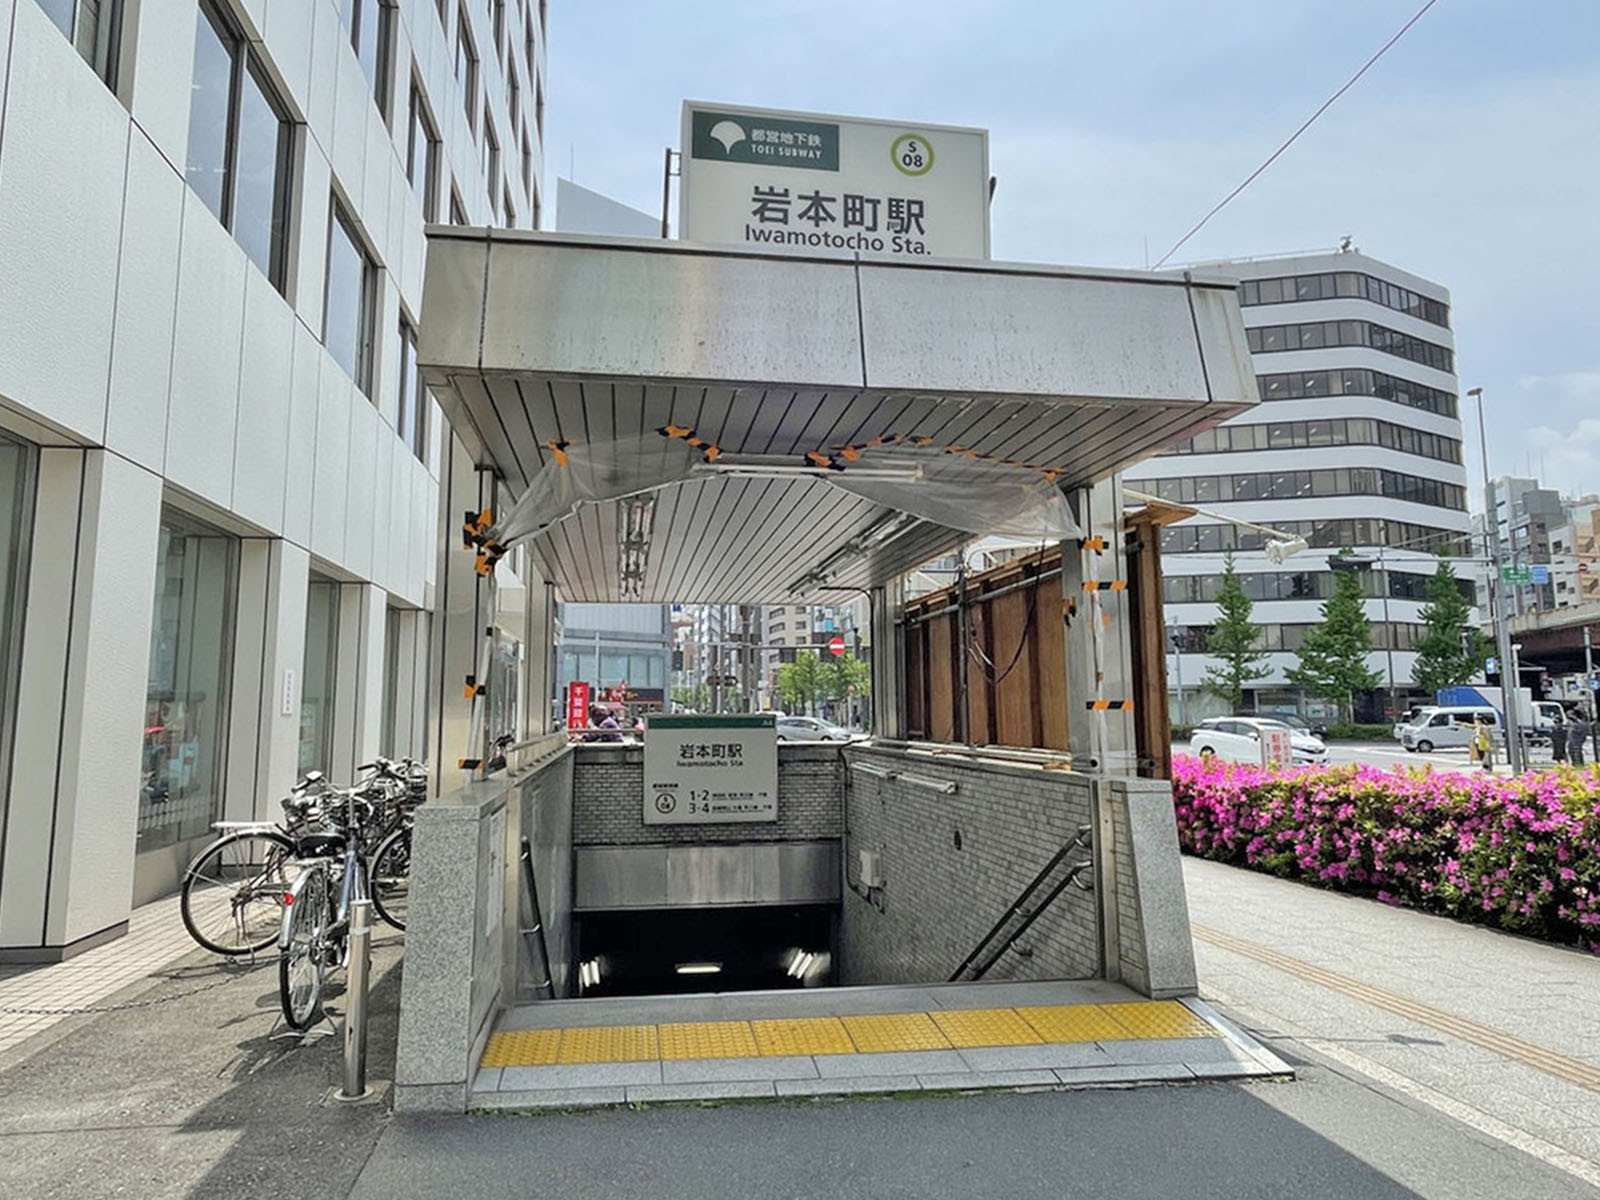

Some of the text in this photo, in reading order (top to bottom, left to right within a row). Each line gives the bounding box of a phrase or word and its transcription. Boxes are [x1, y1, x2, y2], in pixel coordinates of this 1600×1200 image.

[751, 128, 822, 147] 都営地下鉄
[751, 143, 822, 159] TOEI SUBWAY
[908, 141, 917, 153] S
[902, 153, 923, 168] 08
[751, 185, 926, 236] 岩本町駅
[745, 223, 931, 255] Iwamotocho Sta.
[680, 743, 743, 759] 岩本町駅
